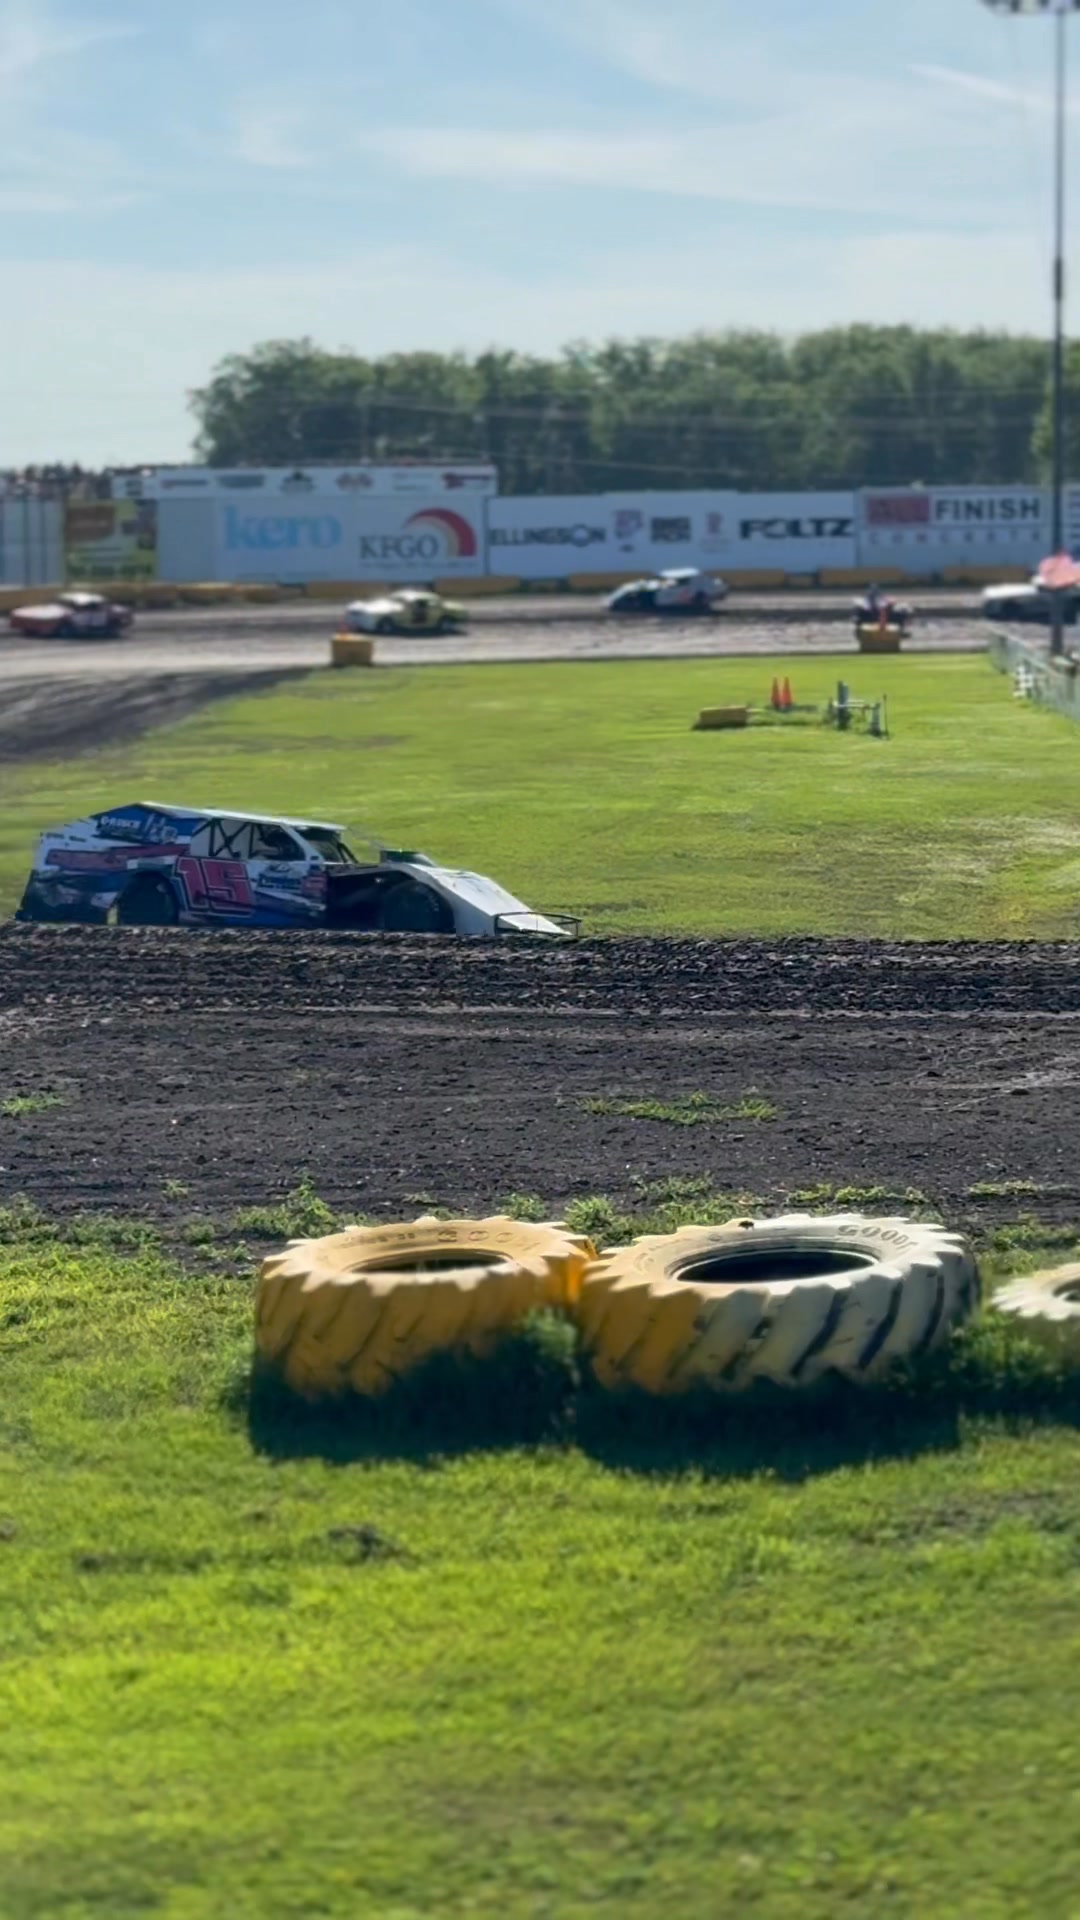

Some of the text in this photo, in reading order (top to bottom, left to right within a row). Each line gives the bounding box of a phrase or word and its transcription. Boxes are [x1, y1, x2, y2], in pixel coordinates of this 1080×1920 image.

[935, 498, 1041, 522] FINISH
[223, 504, 343, 549] kero
[739, 517, 853, 540] FOLTZ
[359, 533, 440, 561] KFGO
[176, 856, 254, 914] 15
